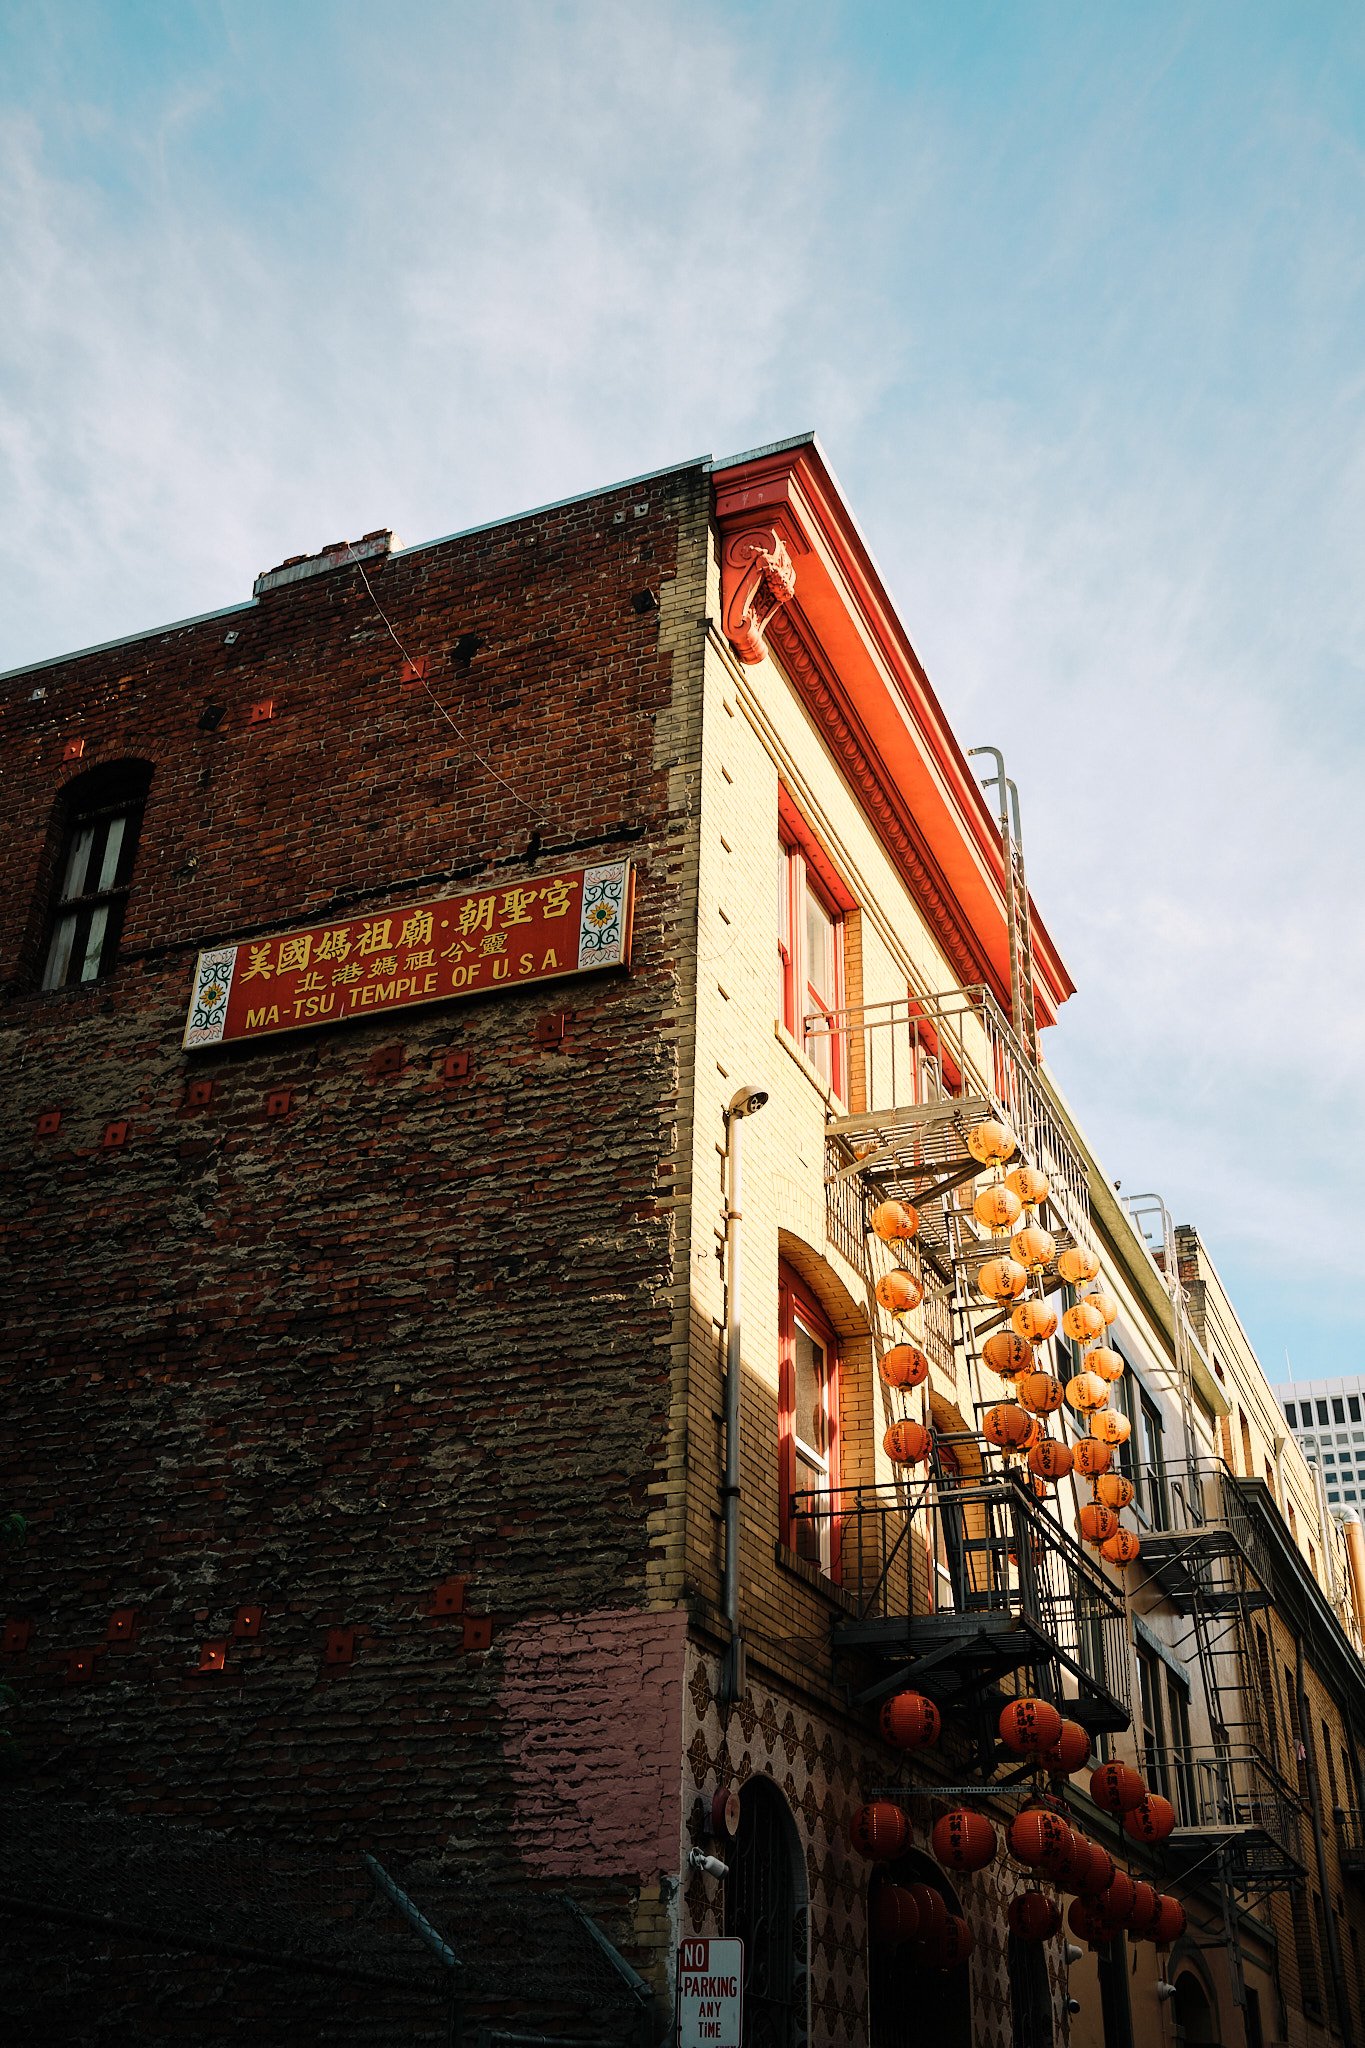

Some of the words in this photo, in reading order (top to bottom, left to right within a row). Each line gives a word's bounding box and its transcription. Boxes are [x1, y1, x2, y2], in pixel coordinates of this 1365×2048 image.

[245, 992, 335, 1029] MA-TSU
[348, 972, 439, 1008] TEMPLE
[452, 963, 482, 987] OF
[684, 1943, 705, 1968] NO
[684, 1976, 737, 1998] PARKING
[698, 2001, 722, 2018] ANY
